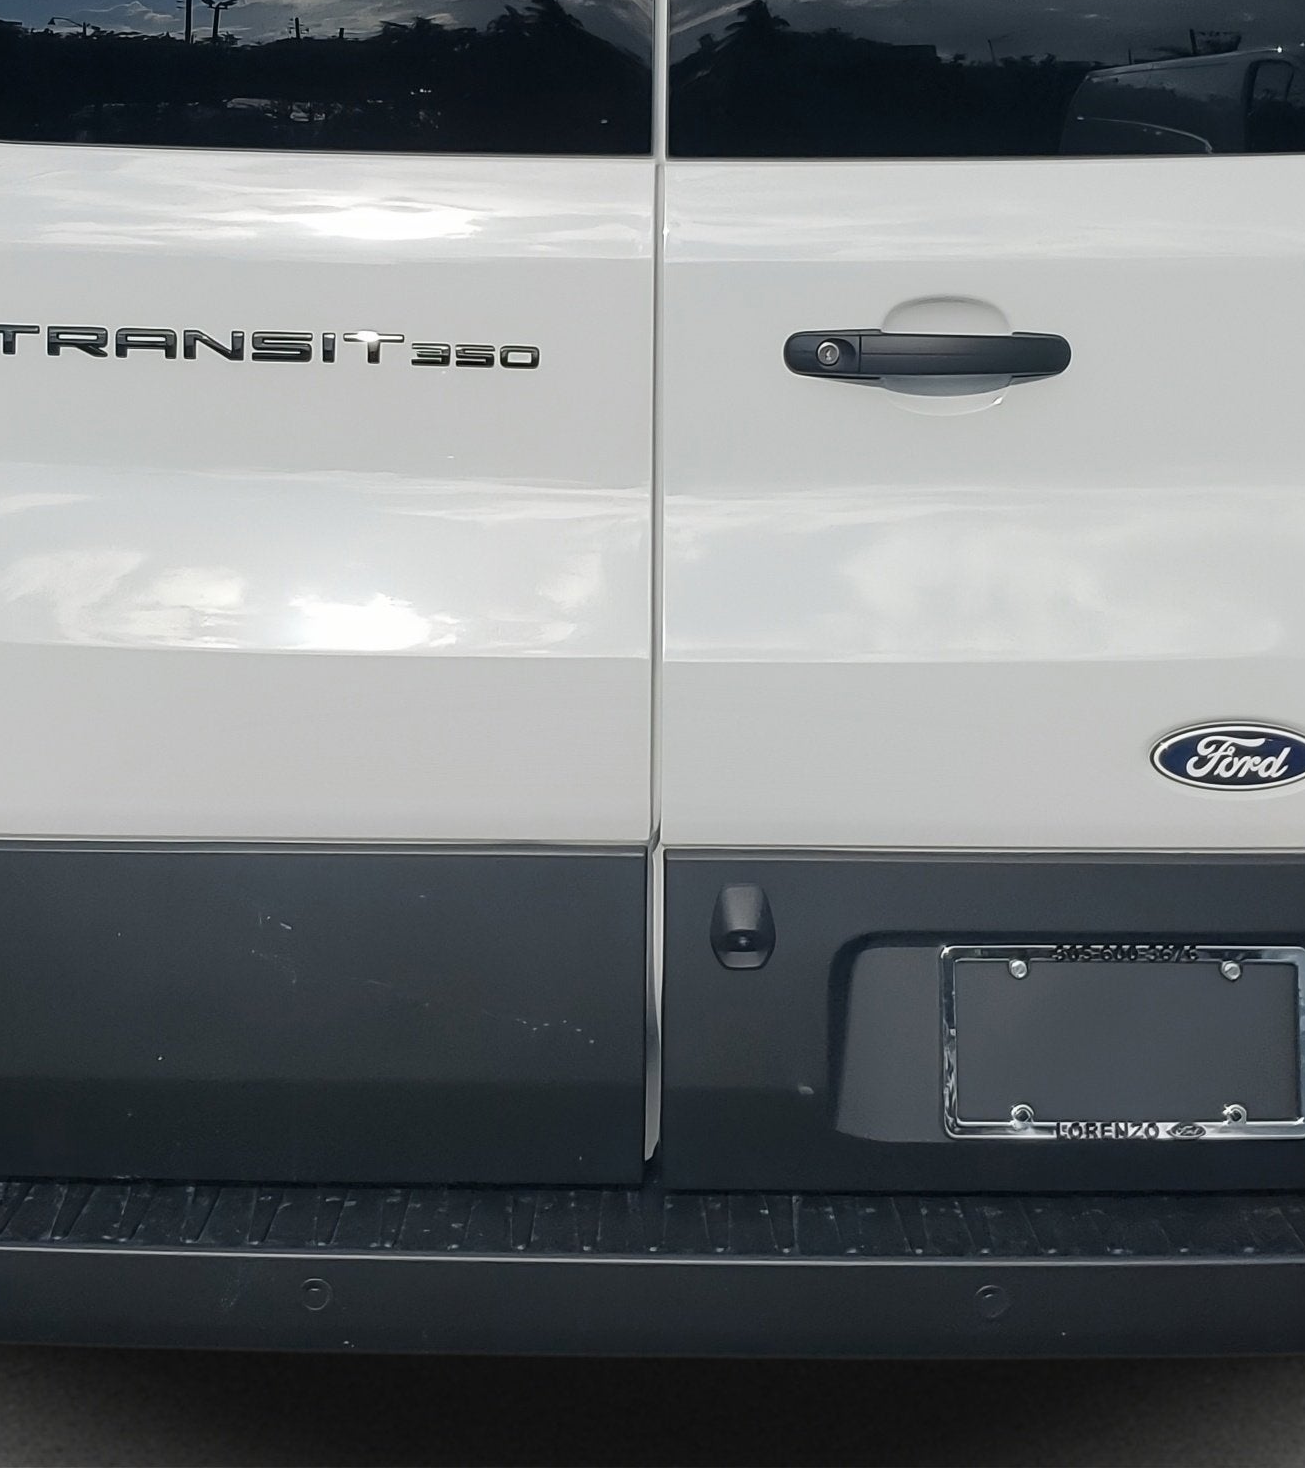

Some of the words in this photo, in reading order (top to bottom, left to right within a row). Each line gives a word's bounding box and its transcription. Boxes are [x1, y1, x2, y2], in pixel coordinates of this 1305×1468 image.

[410, 341, 541, 370] 350
[1185, 735, 1292, 779] Ford
[1055, 1121, 1161, 1140] LORENZO
